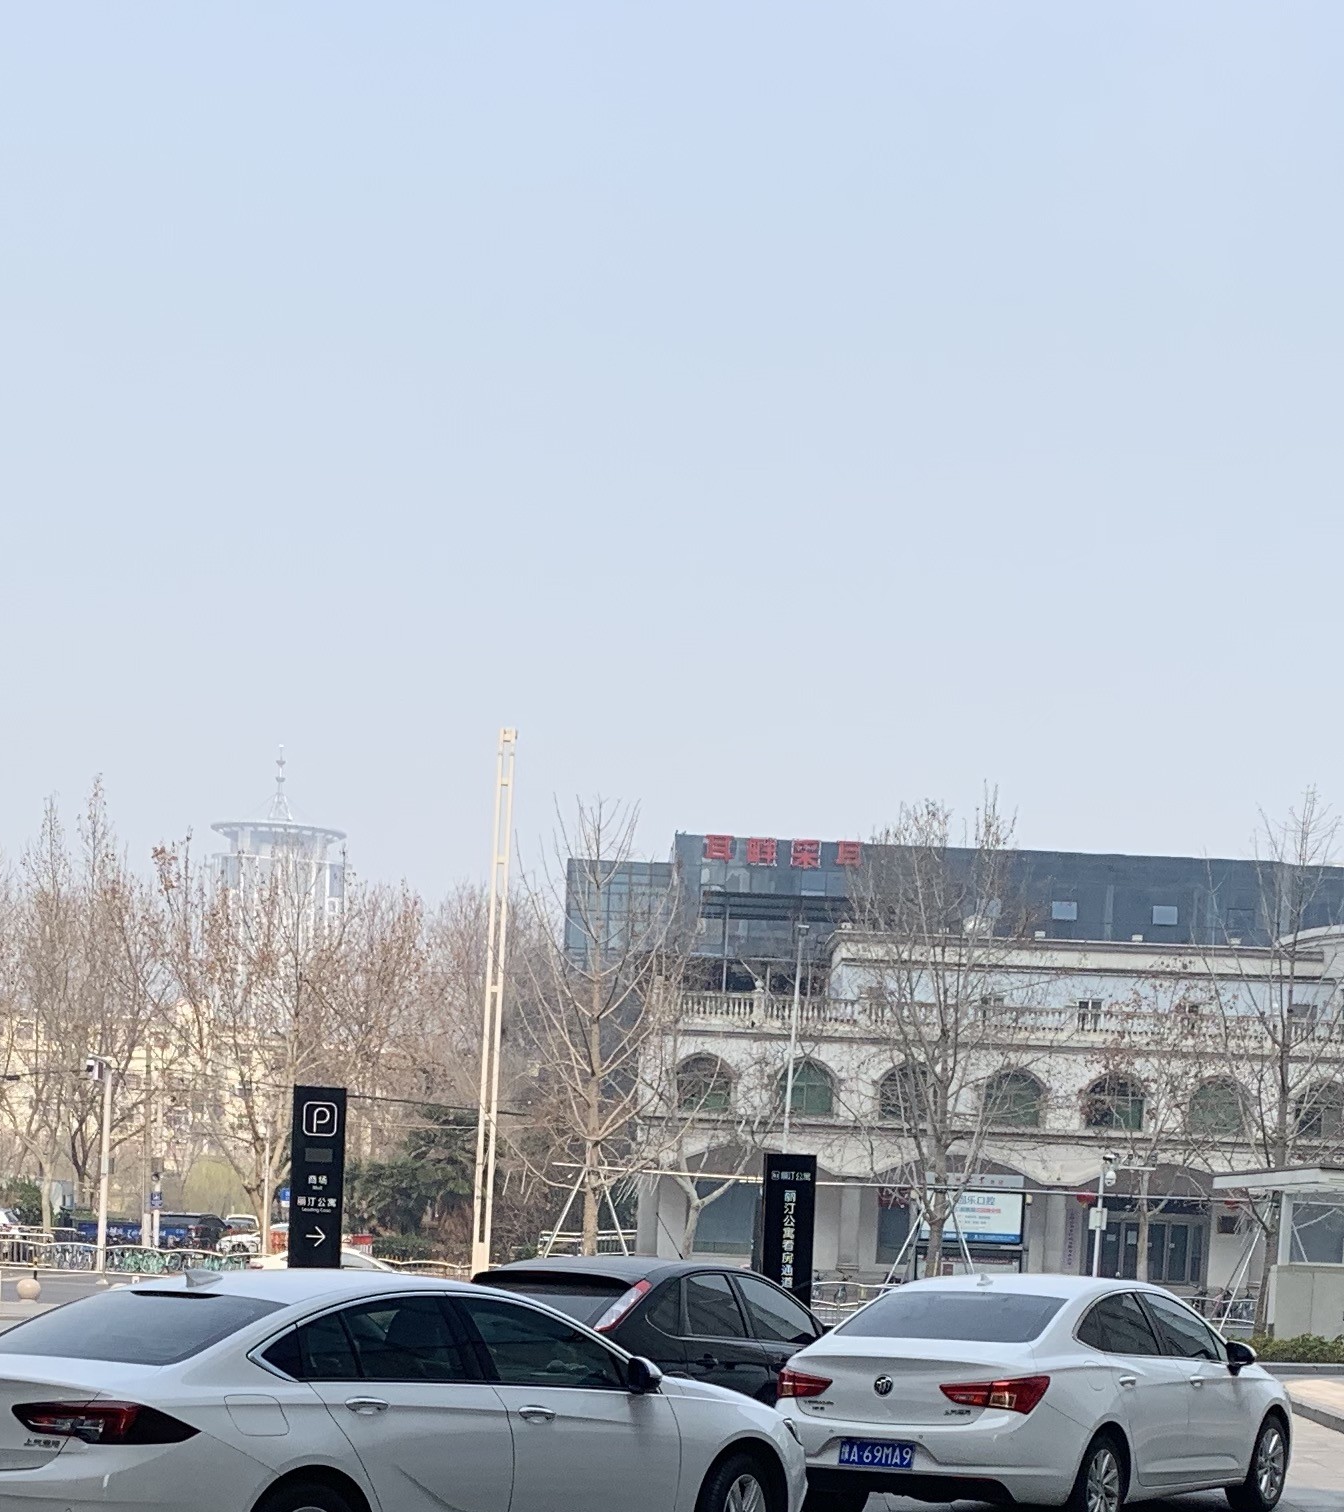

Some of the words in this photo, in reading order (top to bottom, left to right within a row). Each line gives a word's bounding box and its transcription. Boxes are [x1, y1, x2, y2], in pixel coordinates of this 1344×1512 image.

[312, 1106, 331, 1134] P
[308, 1175, 328, 1186] 商场
[296, 1196, 337, 1208] 丽汀公寓
[781, 1189, 797, 1289] 丽汀公寓看房通道
